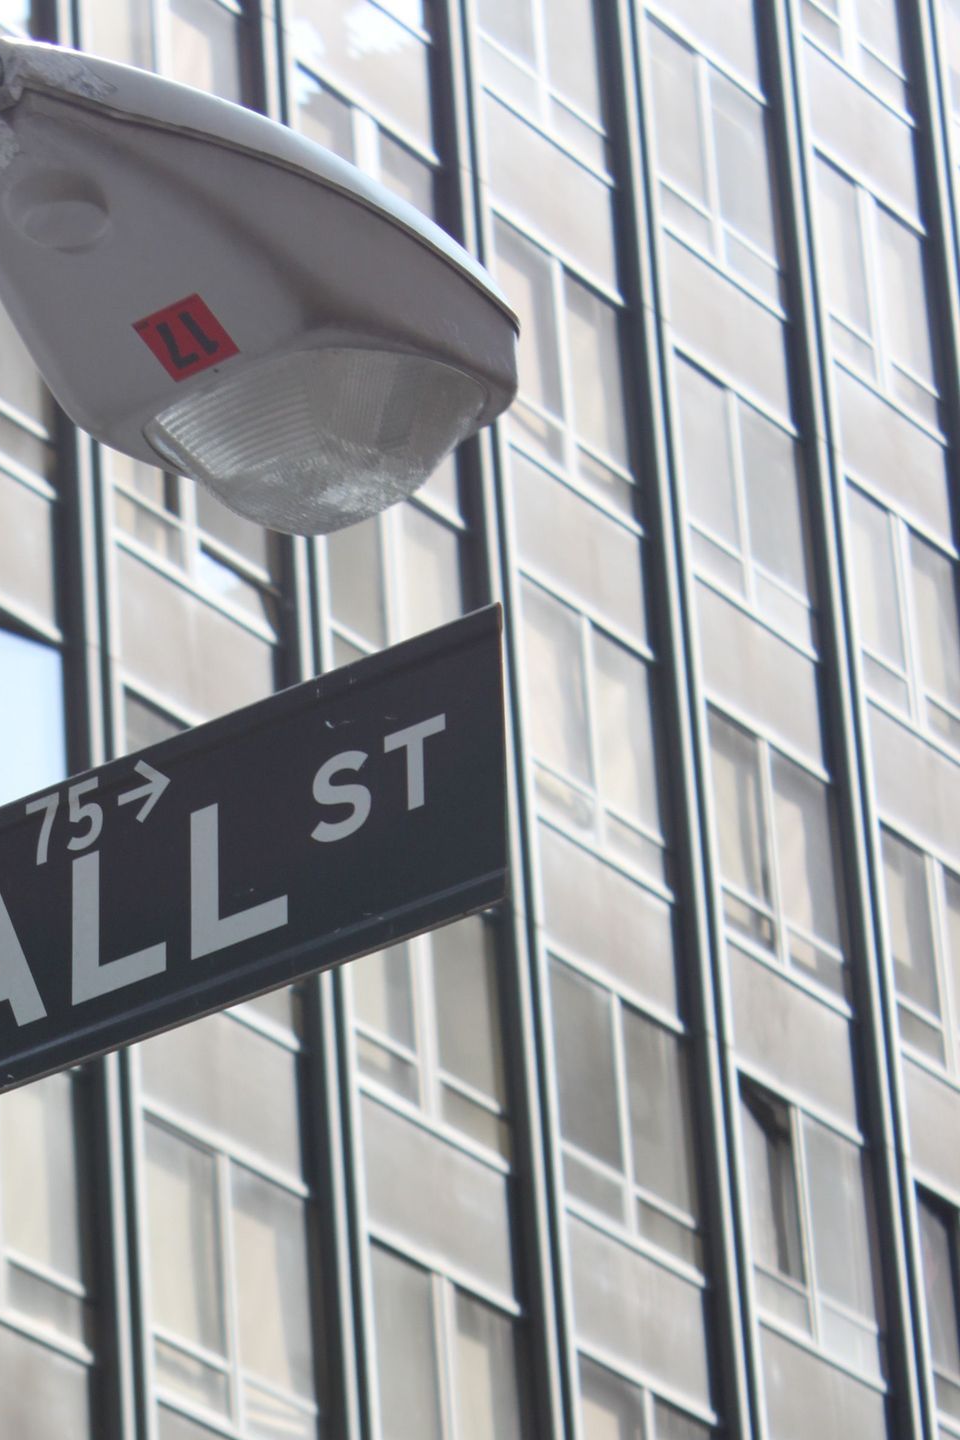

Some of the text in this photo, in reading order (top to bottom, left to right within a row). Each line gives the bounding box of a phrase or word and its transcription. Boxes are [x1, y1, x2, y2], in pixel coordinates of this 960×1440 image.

[155, 310, 220, 369] 17
[25, 775, 104, 866] 75
[310, 713, 446, 843] ST
